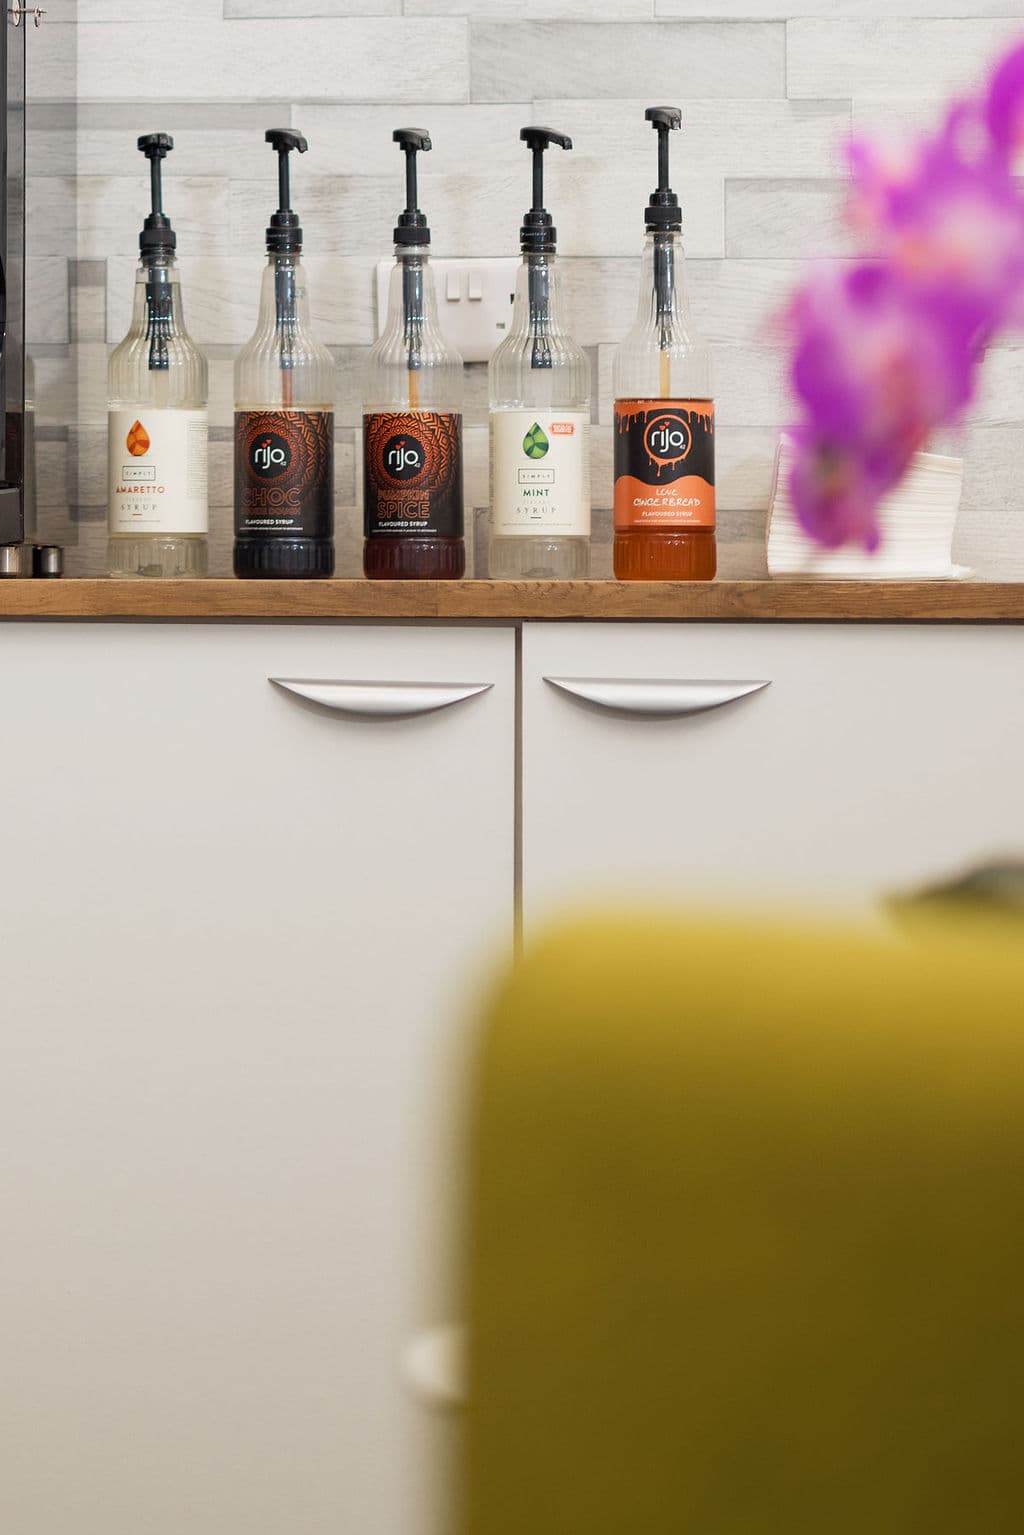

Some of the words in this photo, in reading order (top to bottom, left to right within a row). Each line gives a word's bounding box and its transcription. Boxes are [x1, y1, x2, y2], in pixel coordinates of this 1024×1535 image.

[650, 422, 684, 453] rijo
[254, 438, 285, 469] rijo
[388, 440, 419, 471] rijo
[115, 485, 166, 494] AMARETTO
[240, 487, 302, 506] CHOC
[377, 488, 430, 501] PUMPKIN
[522, 488, 550, 497] MINT
[377, 501, 431, 519] SPICE
[516, 506, 557, 514] SYRUP
